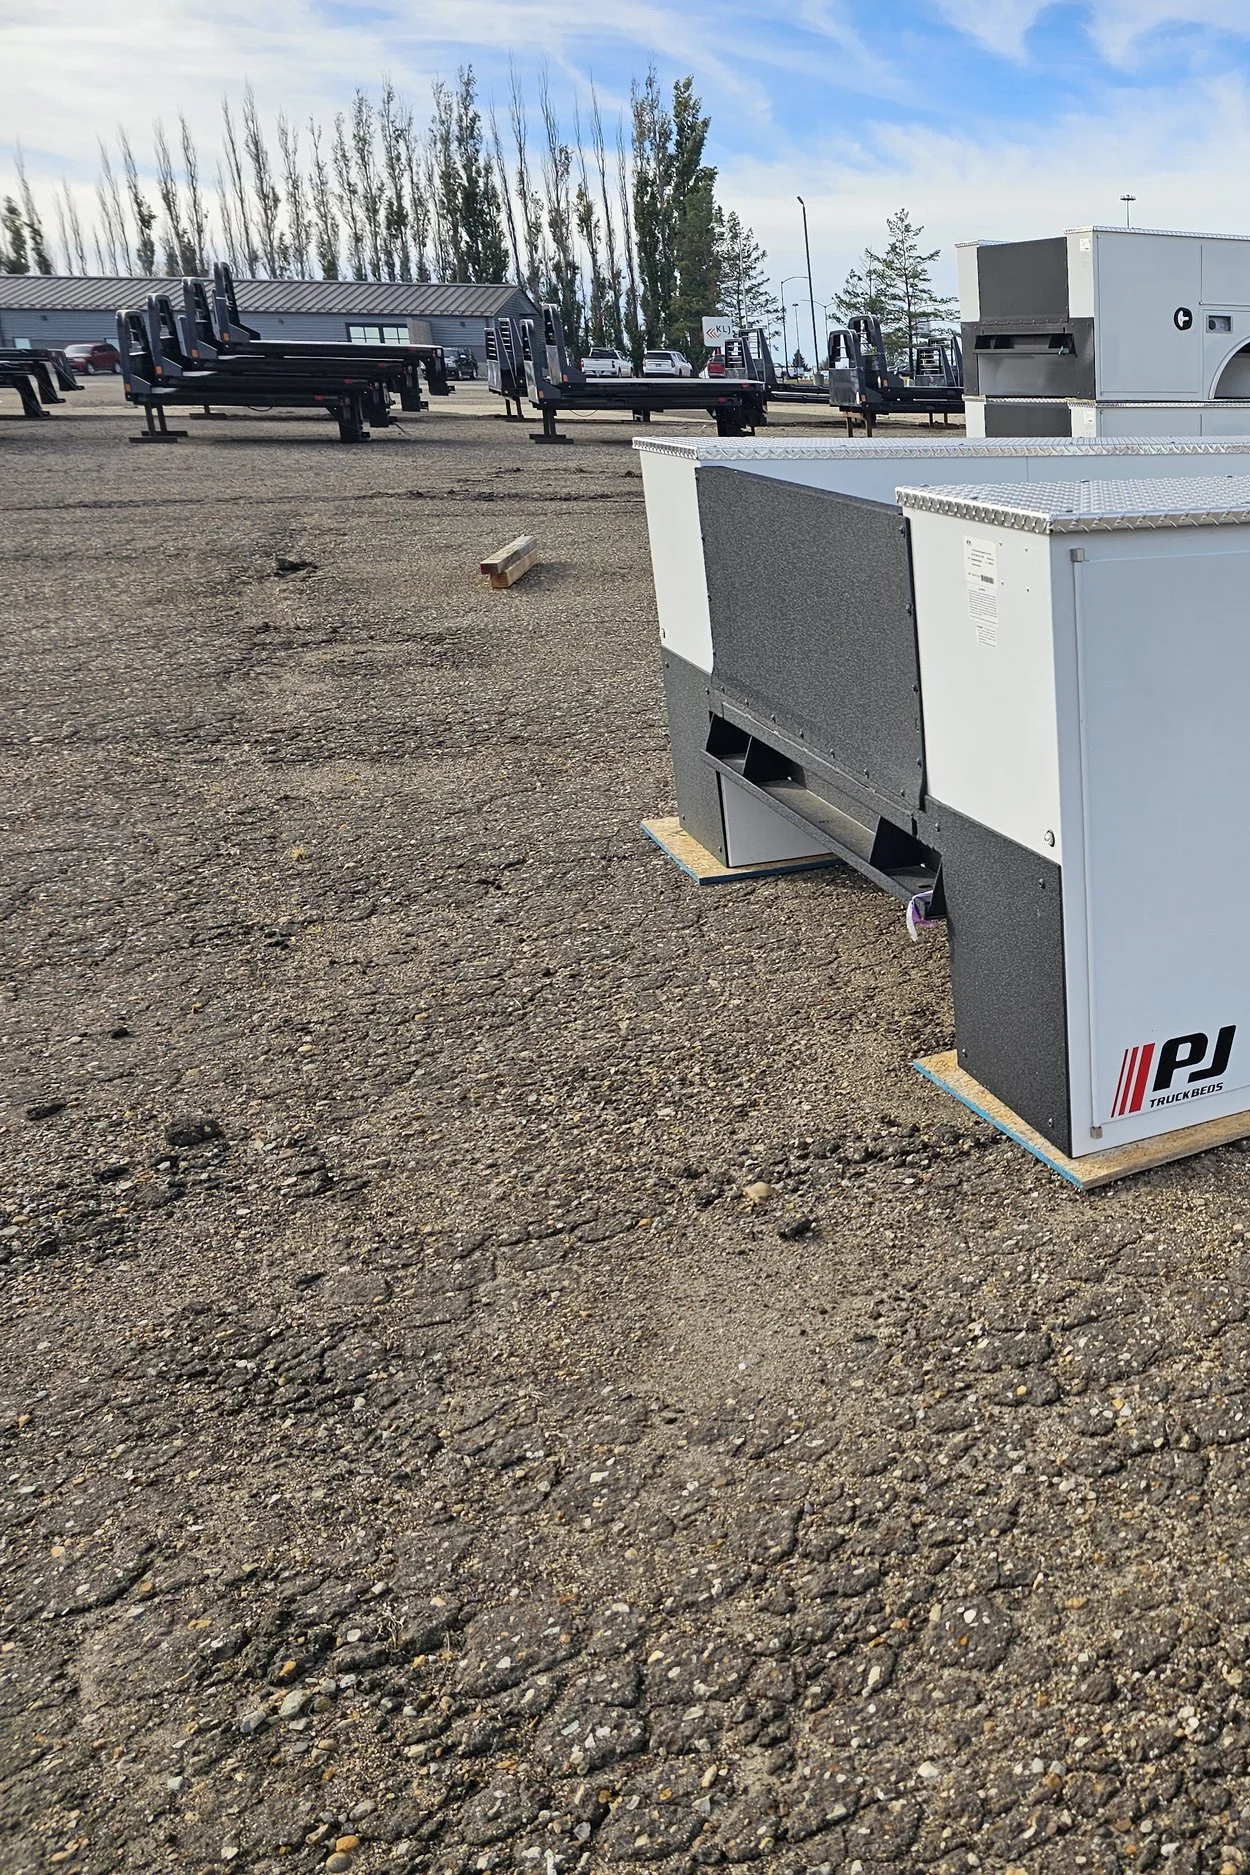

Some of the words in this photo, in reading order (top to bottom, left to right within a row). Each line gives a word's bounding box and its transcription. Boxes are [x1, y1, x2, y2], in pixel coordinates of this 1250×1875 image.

[716, 325, 731, 334] KLJ
[1152, 1025, 1236, 1092] PJ
[1150, 1082, 1223, 1108] TRUCKBEDS
